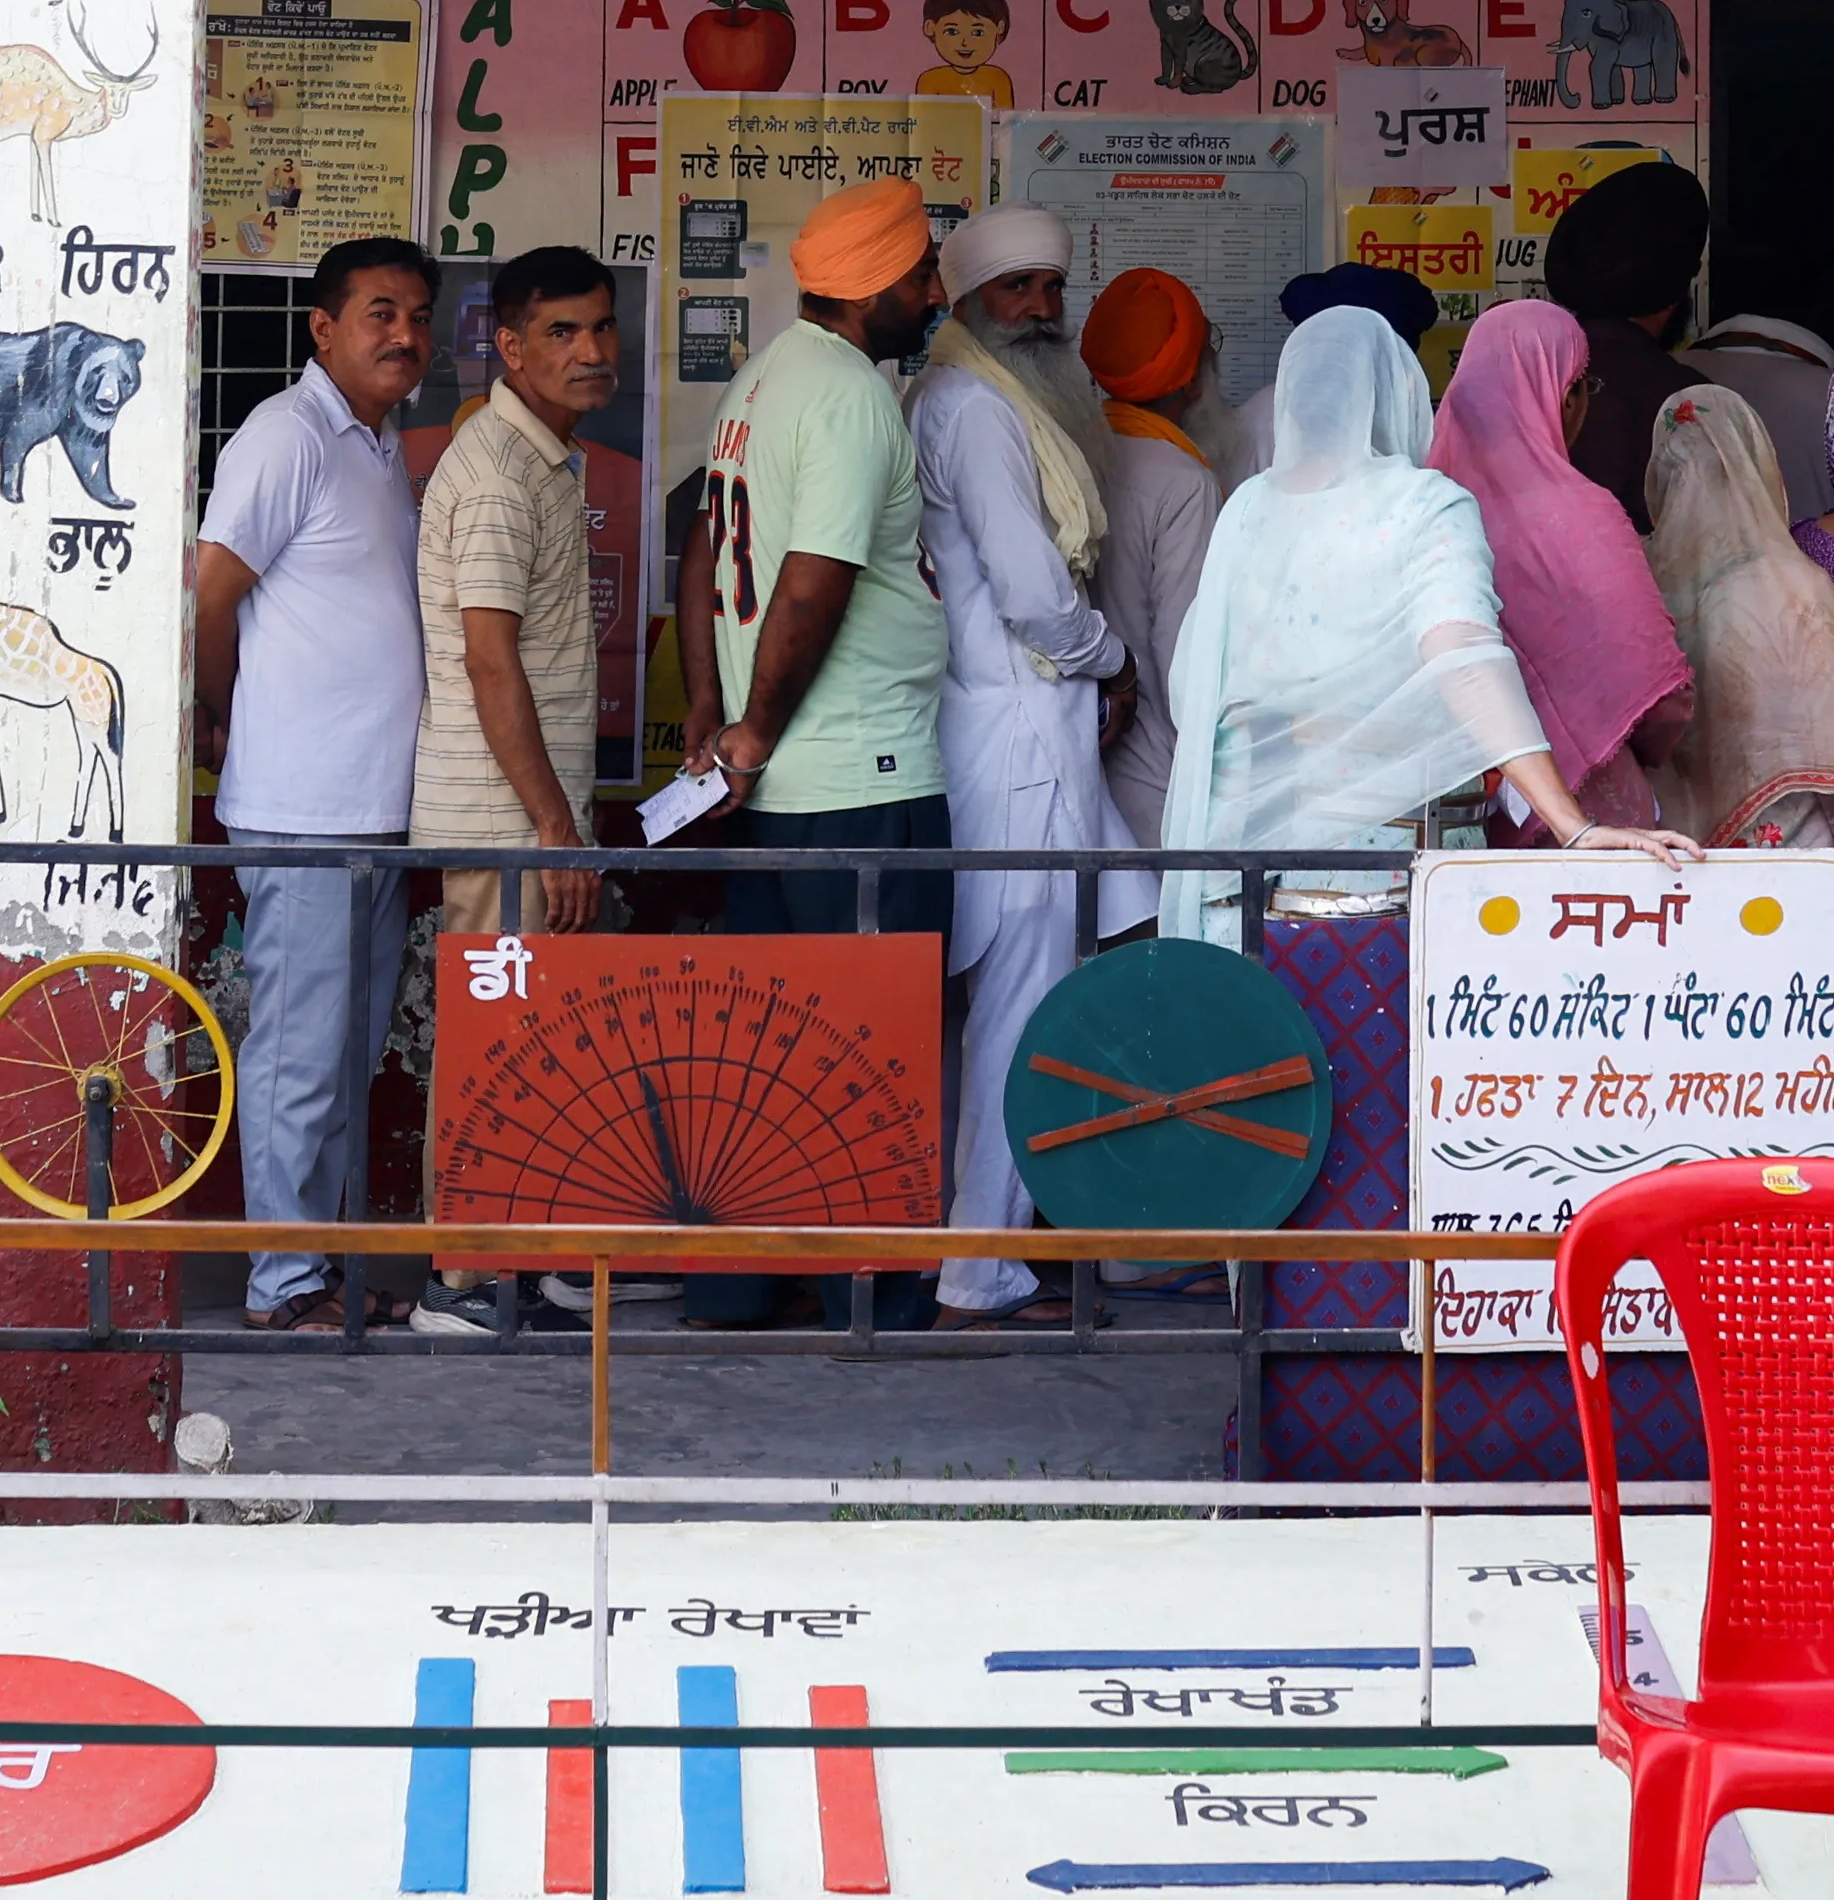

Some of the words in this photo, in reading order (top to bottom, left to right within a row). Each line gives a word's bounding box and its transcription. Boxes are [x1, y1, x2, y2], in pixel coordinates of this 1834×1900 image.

[610, 79, 678, 107] APPL
[1054, 80, 1108, 108] CAT
[1272, 79, 1327, 107] DOG
[1505, 79, 1557, 108] EPHANT
[1106, 134, 1143, 148] ਭਾਰਤ
[1148, 132, 1172, 148] ਚੋਣ
[1375, 107, 1490, 157] ਪੁਰਸ਼
[1079, 153, 1132, 165] ELECTION
[1136, 154, 1206, 166] COMMISSION
[1208, 154, 1223, 166] OF
[1226, 154, 1256, 166] INDIA
[612, 234, 655, 261] FIS
[1496, 239, 1537, 267] JUG
[1549, 882, 1691, 947] ਸਮਾਂ
[1726, 992, 1772, 1040] 60
[1556, 1075, 1580, 1118] 7
